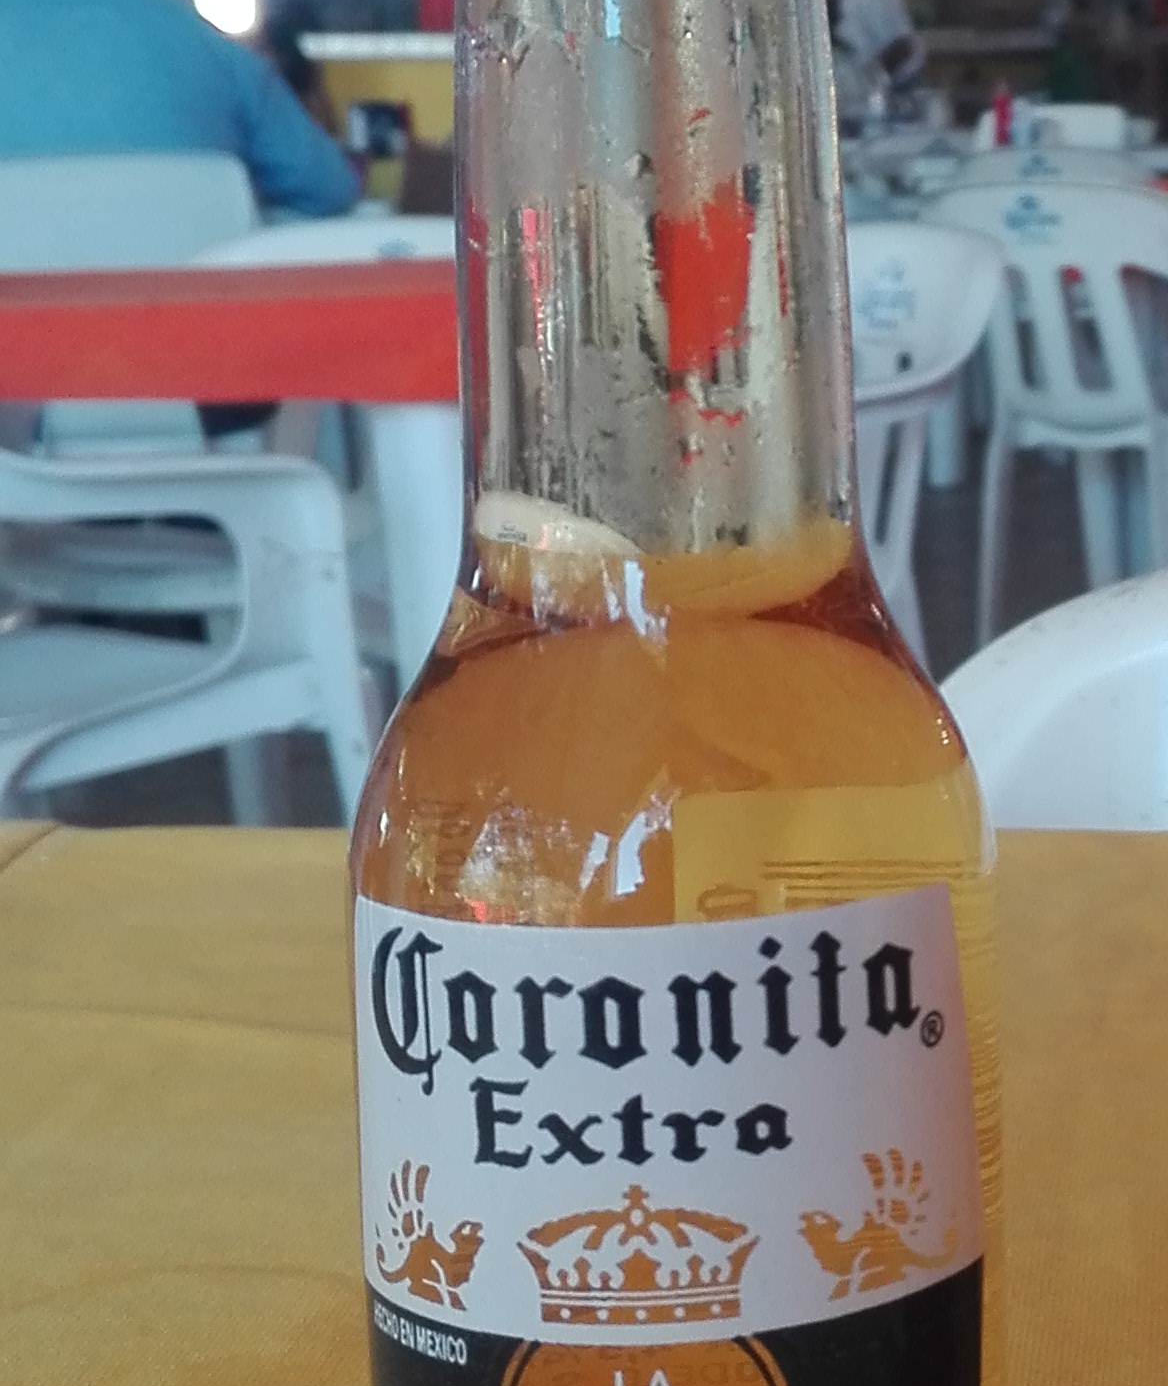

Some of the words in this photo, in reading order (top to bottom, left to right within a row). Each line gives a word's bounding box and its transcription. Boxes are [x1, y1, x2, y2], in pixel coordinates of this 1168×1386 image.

[372, 926, 922, 1095] Coronita
[469, 1077, 795, 1168] Extra
[400, 1317, 416, 1349] EN
[415, 1324, 468, 1366] MEXICO
